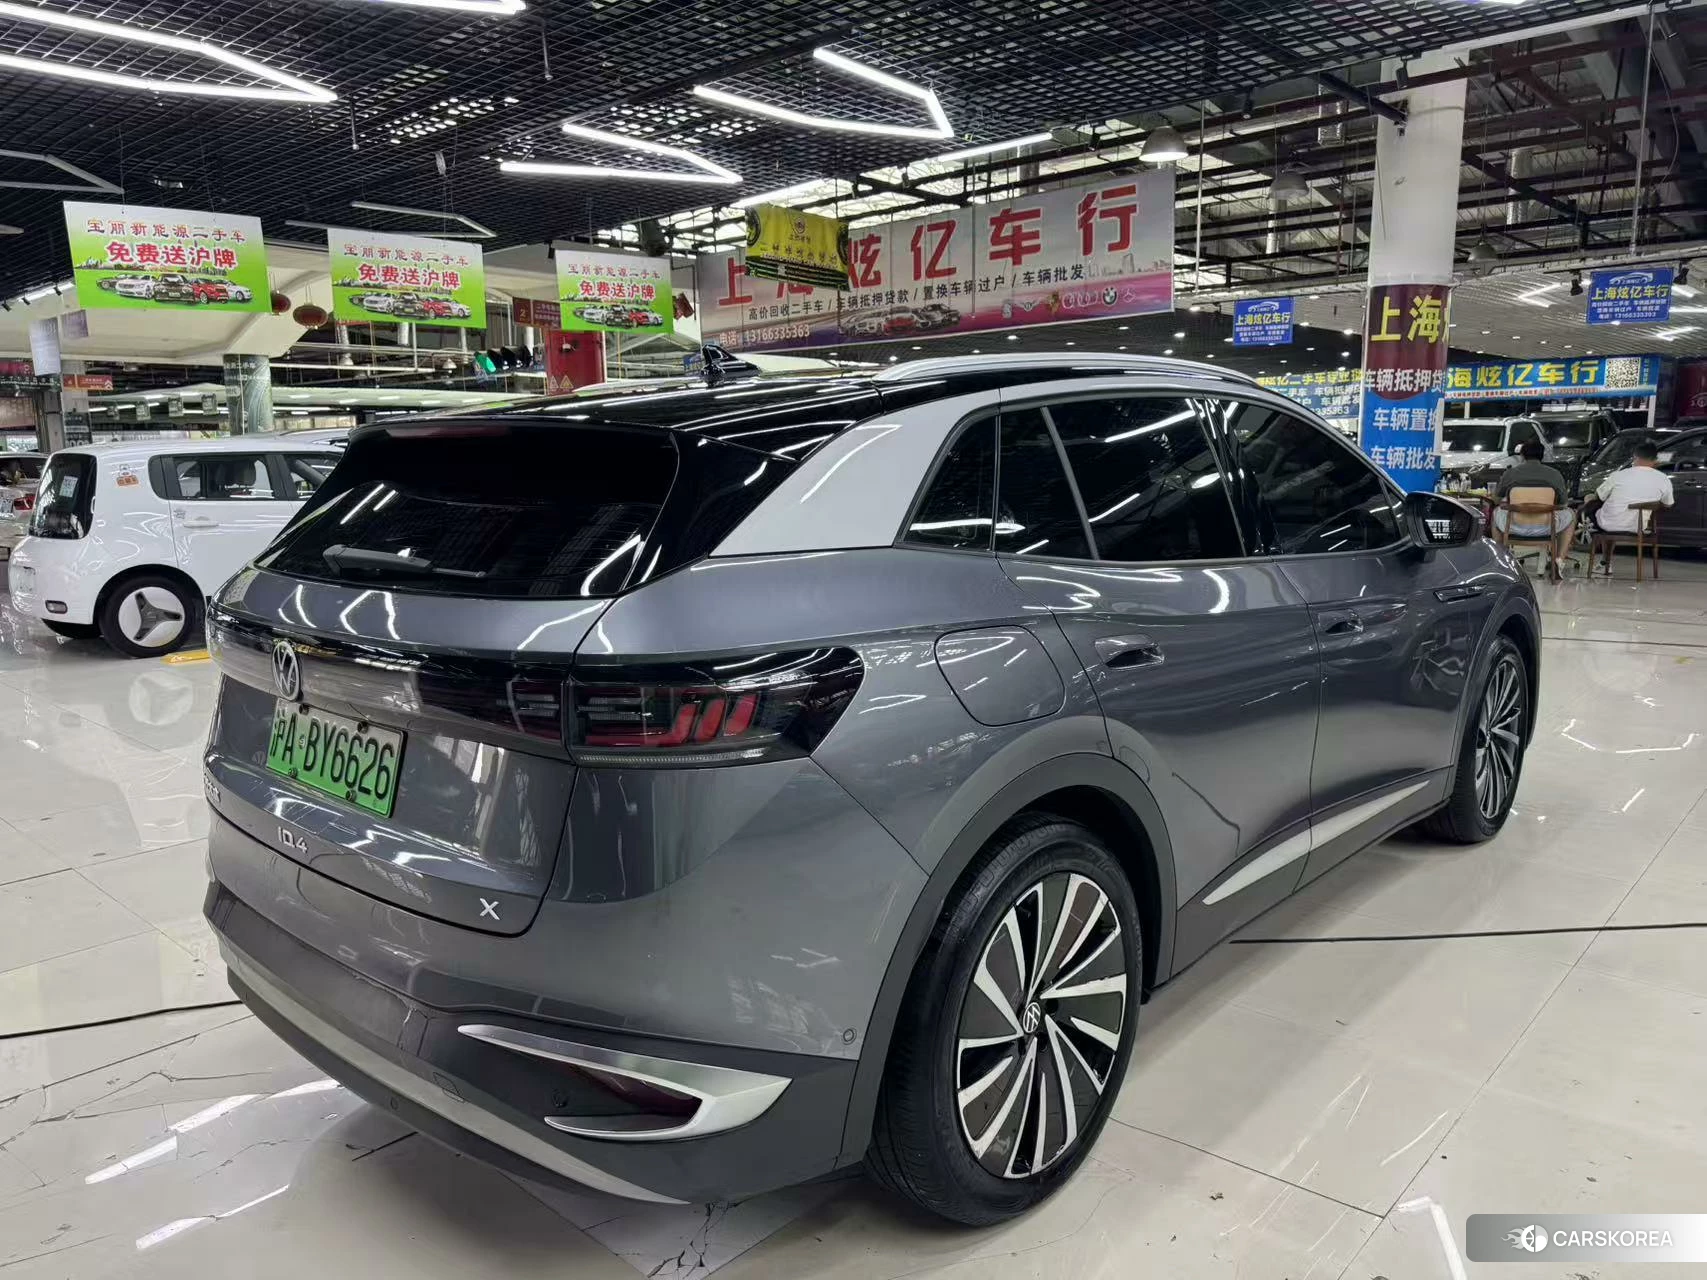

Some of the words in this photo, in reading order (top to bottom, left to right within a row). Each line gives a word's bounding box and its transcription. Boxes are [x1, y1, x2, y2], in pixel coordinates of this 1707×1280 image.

[106, 240, 238, 269] 免费送沪牌
[718, 184, 1137, 305] 上炫亿车行
[357, 263, 461, 288] 免费送沪牌
[579, 280, 656, 300] 免费送沪牌
[748, 299, 823, 321] 高价回收二手车
[836, 288, 909, 312] 车辆抵押贷款
[923, 274, 1006, 301] 置换车辆过户
[1022, 263, 1085, 285] 车辆批发
[1591, 284, 1670, 301] 上海炫亿车行
[1446, 360, 1600, 389] 海炫亿车行
[479, 897, 500, 920] X
